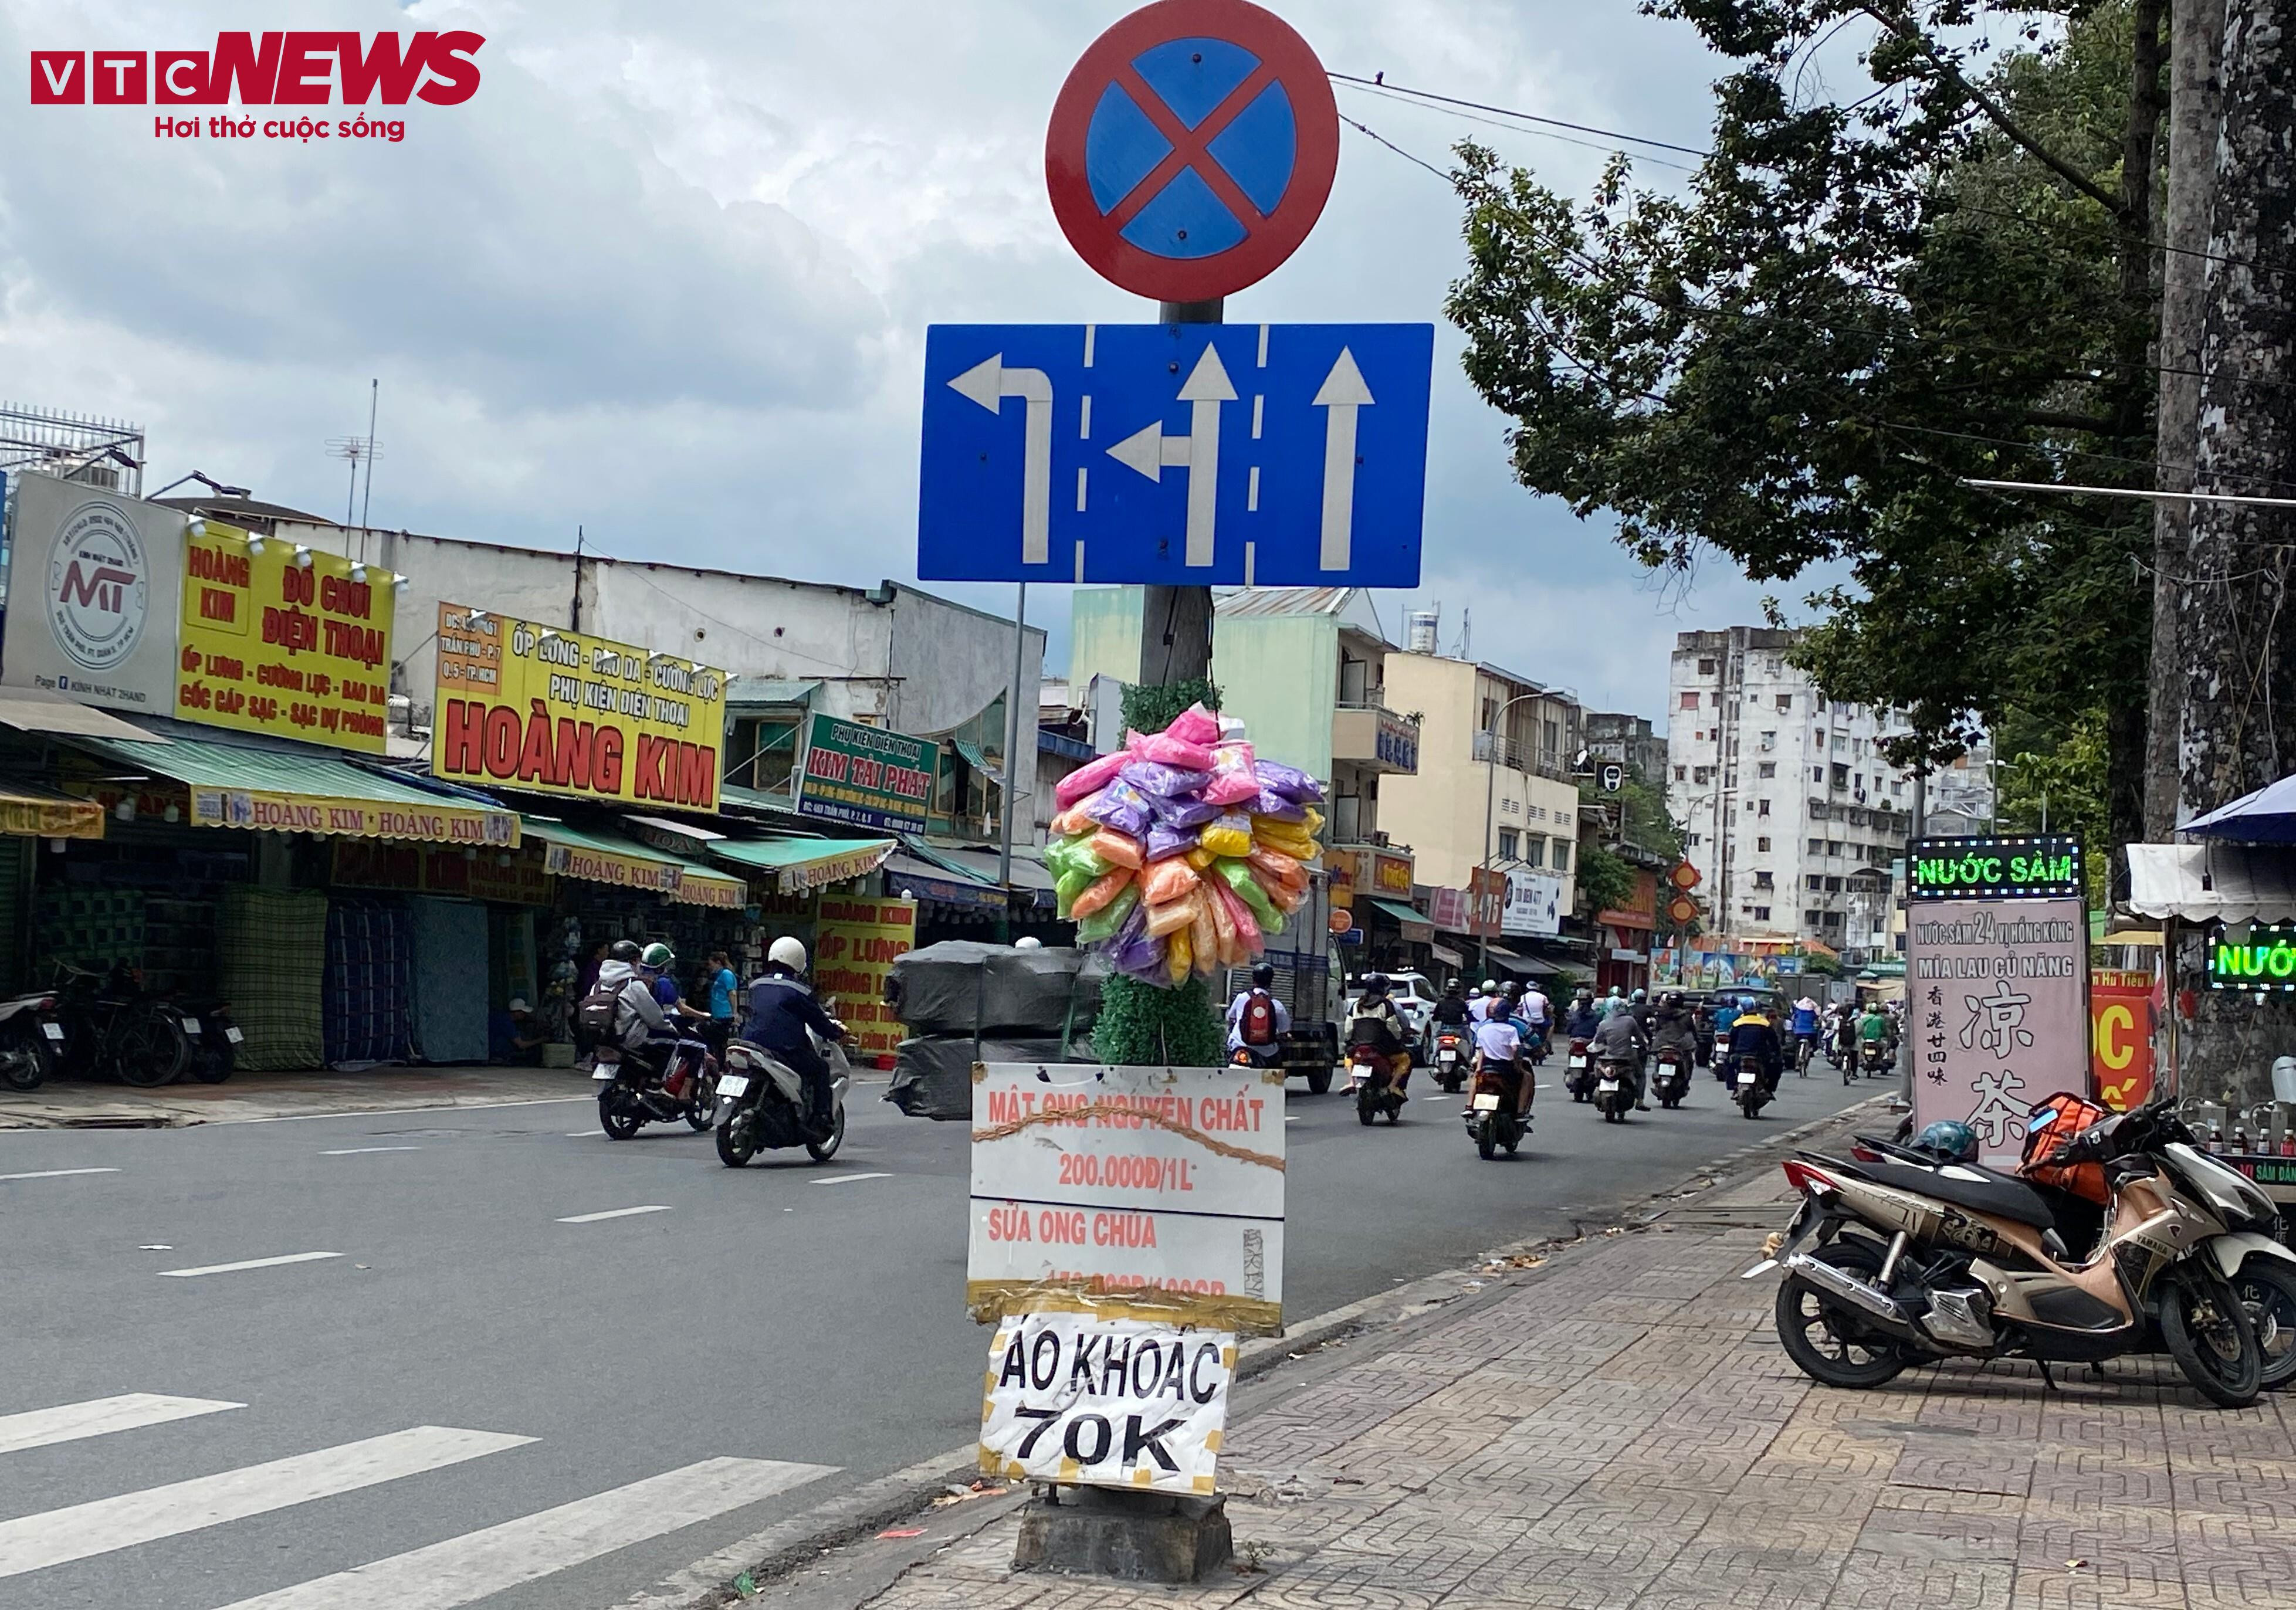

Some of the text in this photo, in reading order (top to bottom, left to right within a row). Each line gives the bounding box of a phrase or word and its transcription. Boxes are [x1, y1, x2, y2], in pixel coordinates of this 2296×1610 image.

[189, 545, 250, 587] HOÀNG
[201, 587, 235, 623] KIM
[262, 605, 385, 670] ĐIỆN THOẠI
[35, 674, 56, 690] Page
[181, 644, 202, 673] ỐP
[205, 654, 243, 682] LƯNG
[256, 663, 303, 692] CƯỜNG
[306, 673, 331, 698] LỰC
[512, 621, 534, 657] ỐP
[623, 655, 642, 683] DA
[653, 661, 695, 696] CƯỜNG
[696, 675, 719, 704] LỰC
[248, 696, 277, 723] SẠC
[289, 703, 317, 730] SẠC
[320, 707, 340, 734] DỰ
[341, 709, 384, 737] PHÒNG
[550, 674, 690, 731] PHỤ KIỆN ĐIỆN THOẠI
[445, 698, 716, 809] HOÀNG KIM
[831, 723, 850, 746] PHỤ
[851, 727, 873, 751] KIỆN
[896, 740, 922, 762] THOẠI
[807, 746, 849, 782] KIM
[882, 764, 932, 800] PHÁT
[253, 798, 484, 839] HOÀNG KIM HOÀNG KIM
[573, 857, 625, 880] HOÀNG
[631, 866, 659, 888] KIM
[1918, 852, 2002, 884] NƯỚC
[881, 906, 912, 925] KIM
[1973, 911, 1996, 945] 24
[1997, 923, 2010, 948] VỊ
[2043, 918, 2074, 943] KÔNG
[818, 927, 847, 960] ỐP
[1918, 950, 2074, 979] MÍA LAU CỦ NĂNG
[1042, 1093, 1089, 1127] ONG
[1200, 1084, 1264, 1131] CHẤT
[1039, 1211, 1086, 1245] ONG
[2136, 1233, 2168, 1255] YAMAHA
[1014, 1400, 1188, 1472] 70K
